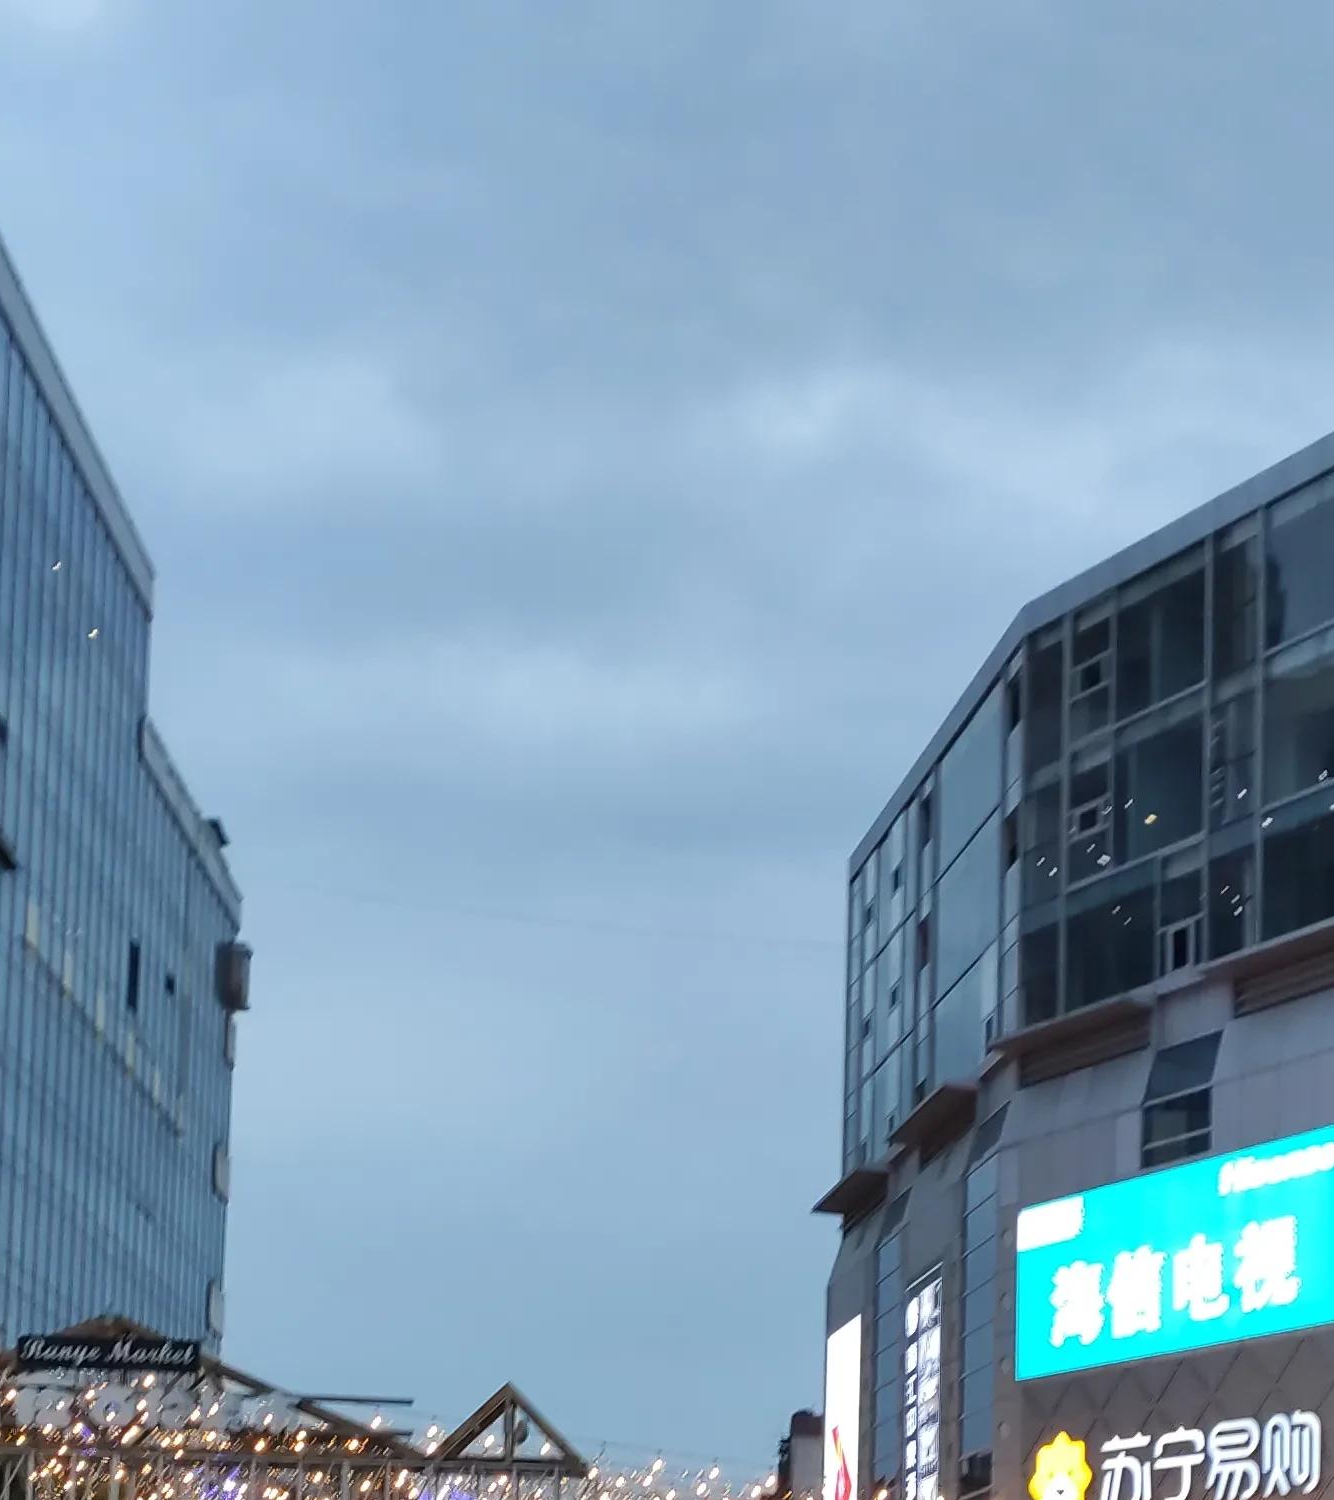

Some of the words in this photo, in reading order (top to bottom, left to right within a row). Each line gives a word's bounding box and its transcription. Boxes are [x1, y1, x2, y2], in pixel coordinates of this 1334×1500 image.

[1048, 1214, 1303, 1348] 海信电视
[105, 1335, 196, 1366] Market
